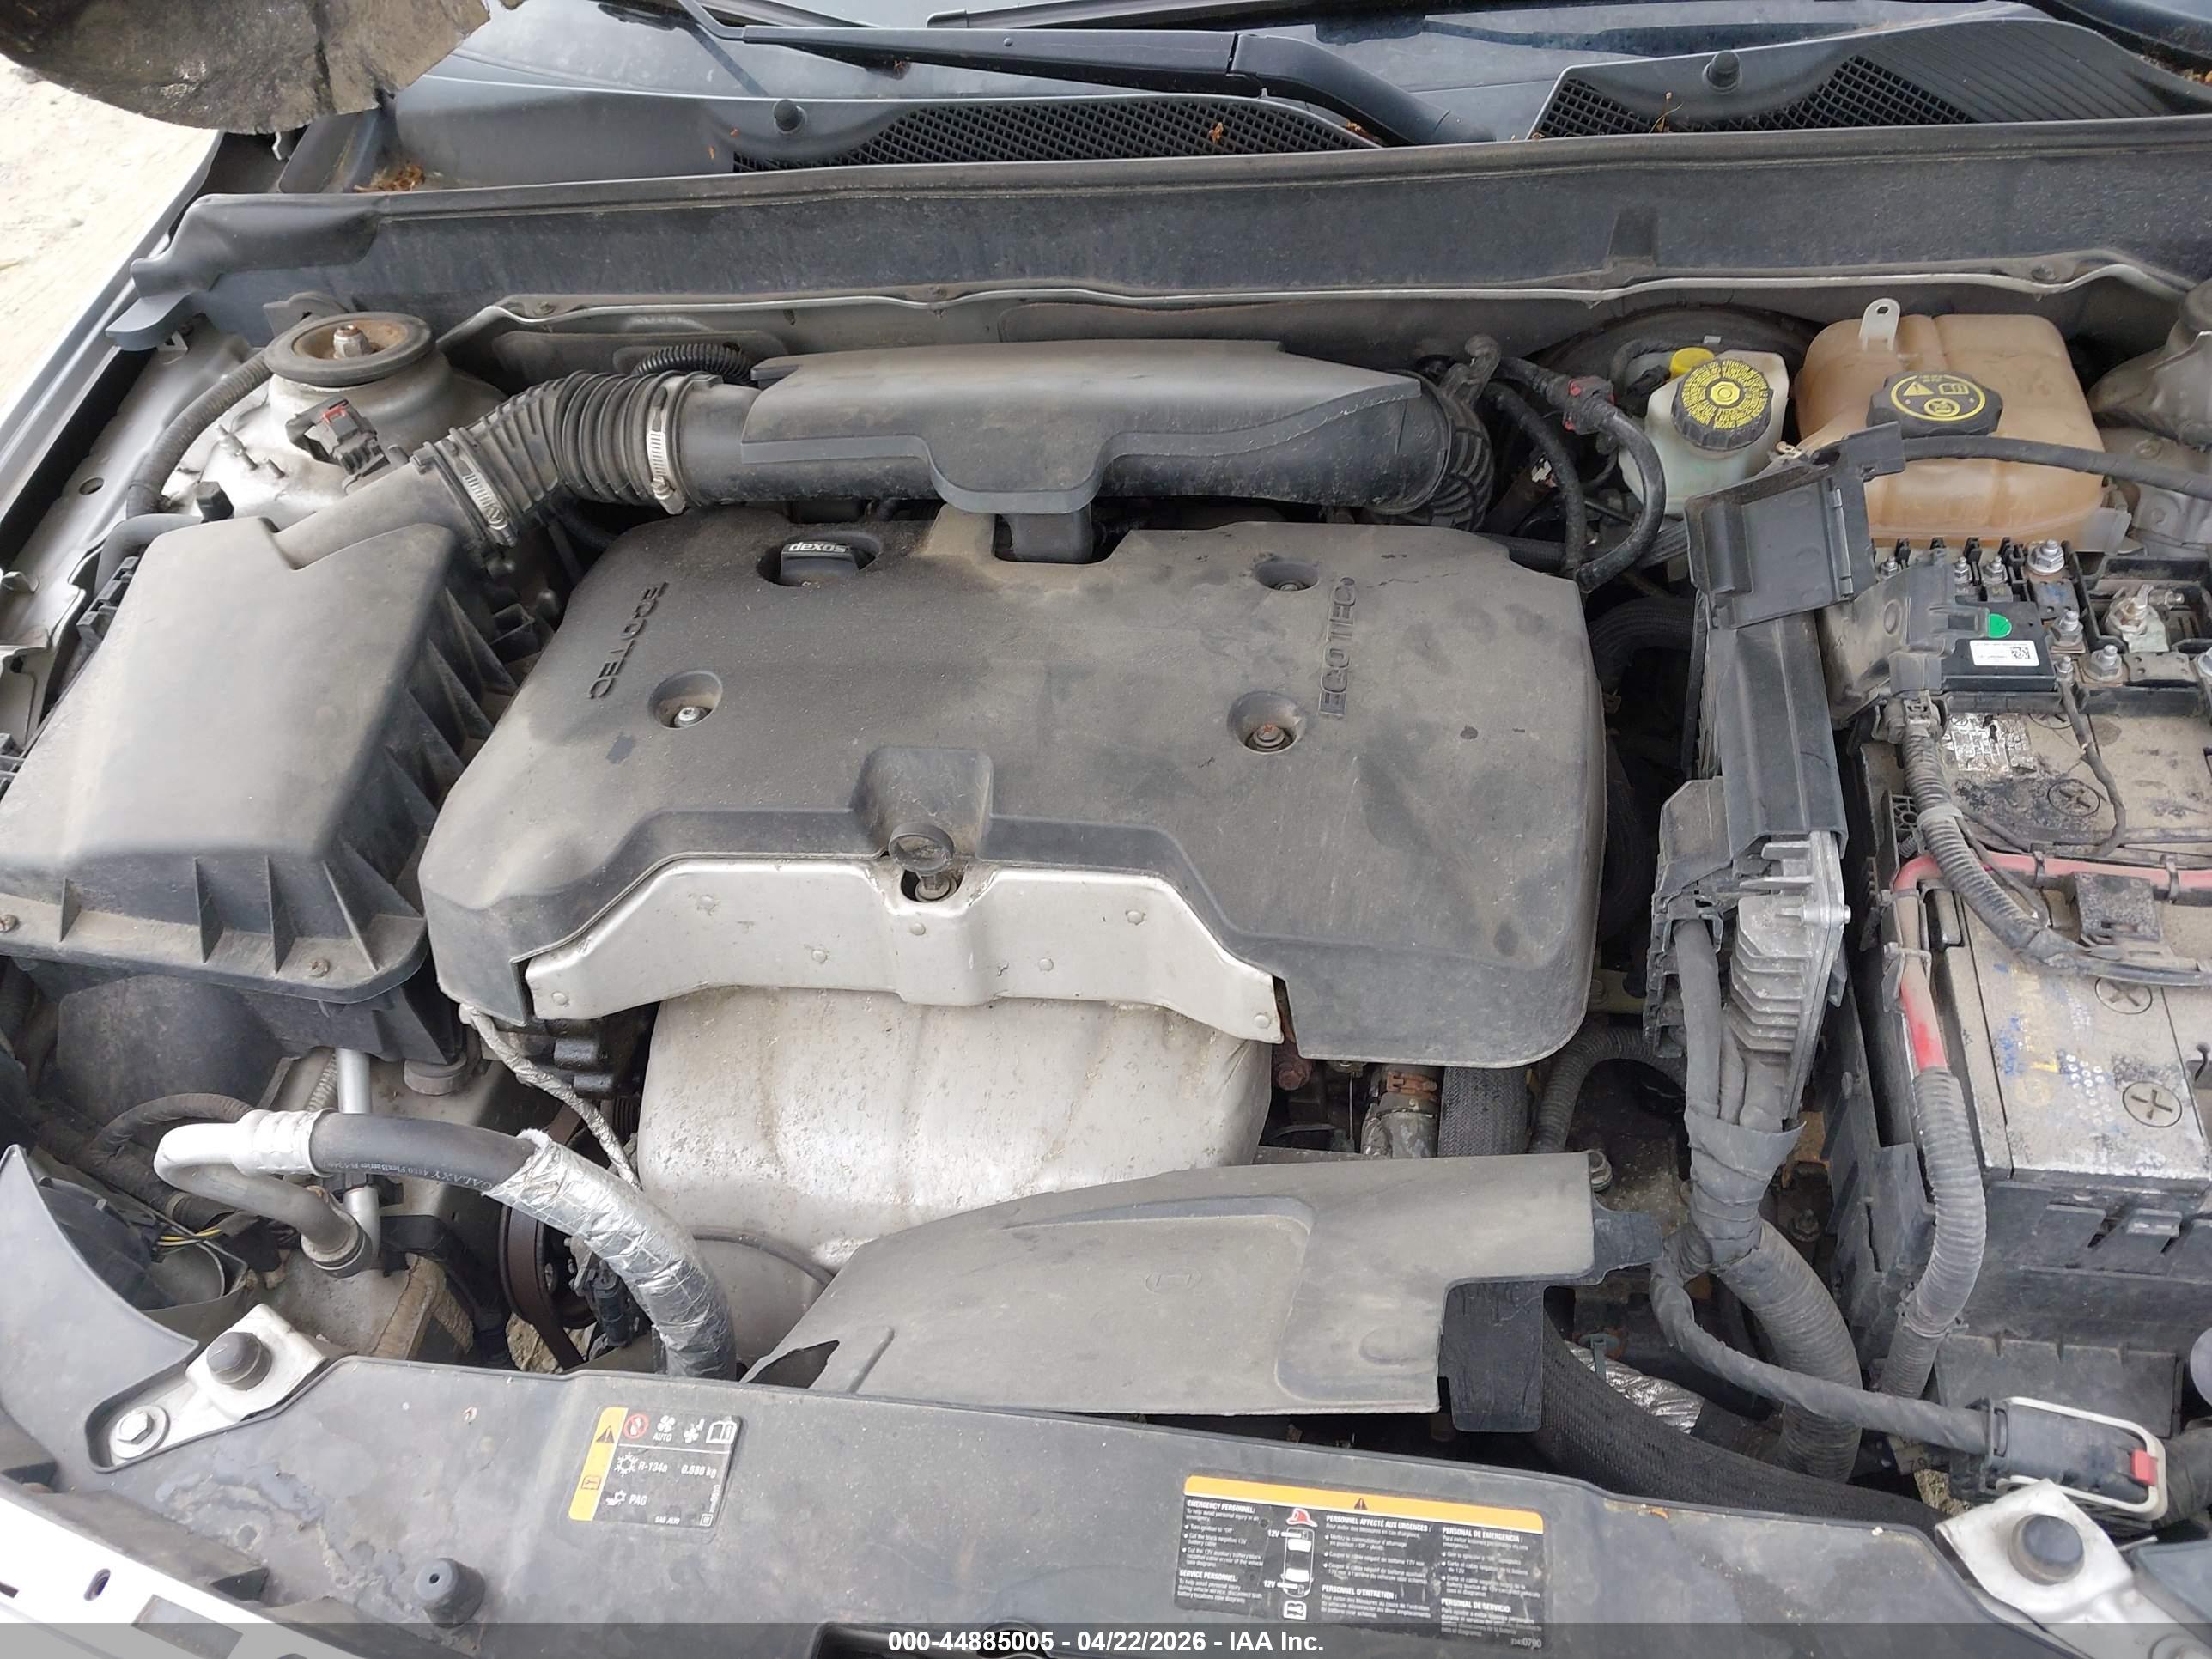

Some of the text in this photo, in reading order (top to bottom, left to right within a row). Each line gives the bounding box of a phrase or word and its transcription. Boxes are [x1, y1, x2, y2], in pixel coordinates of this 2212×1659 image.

[788, 541, 848, 553] dexos
[588, 581, 669, 699] ECOTEC
[1319, 583, 1357, 715] ECOTEC
[431, 1169, 493, 1190] GALAXY
[653, 1432, 672, 1442] AUTO
[638, 1461, 668, 1473] R-134a
[706, 1466, 717, 1479] kg
[629, 1494, 647, 1506] PAG
[1187, 1499, 1220, 1510] EMERGENCY
[1385, 1520, 1396, 1528] AUX
[1267, 1529, 1279, 1538] 12V
[1473, 1529, 1480, 1538] DE
[1179, 1569, 1202, 1578] SERVICE
[1263, 1580, 1276, 1589] 12V
[1473, 1601, 1480, 1609] DE
